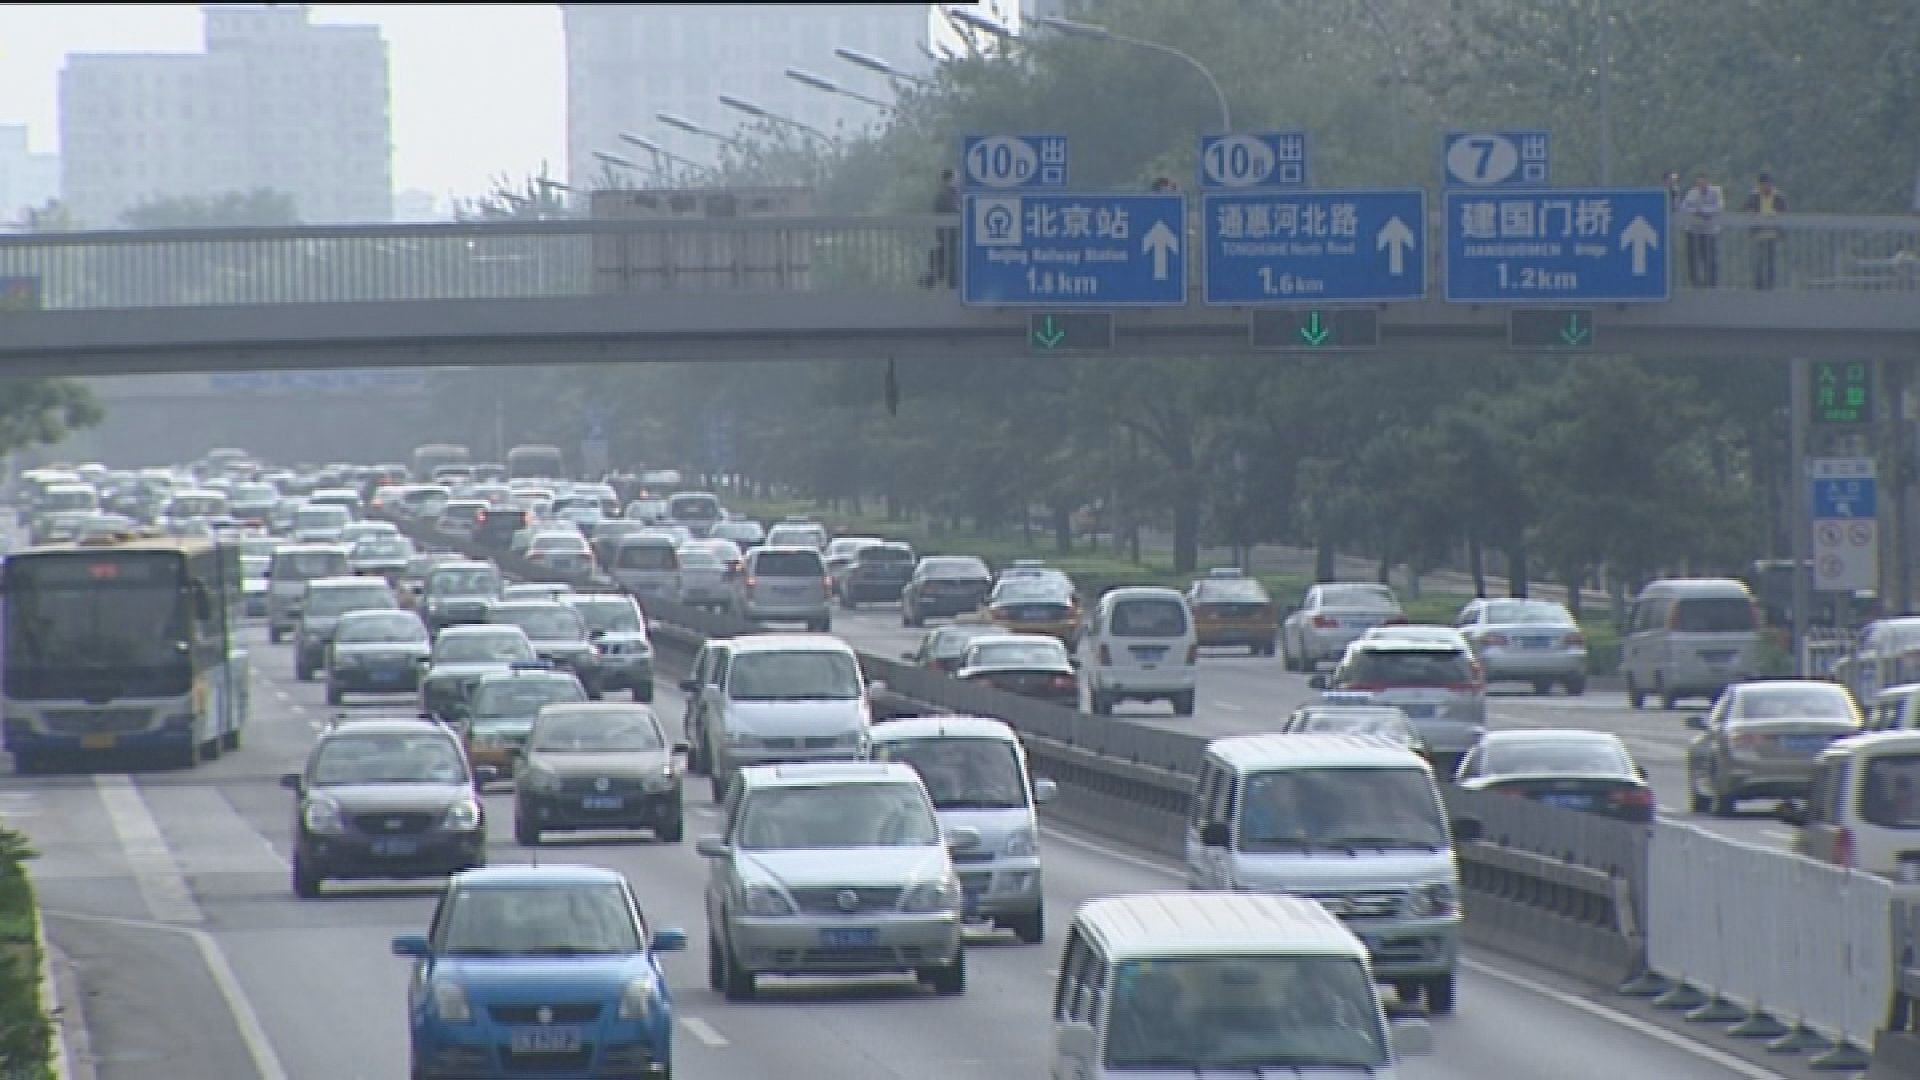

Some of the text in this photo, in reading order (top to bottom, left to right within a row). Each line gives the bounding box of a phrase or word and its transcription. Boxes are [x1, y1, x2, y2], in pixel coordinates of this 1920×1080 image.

[1042, 136, 1066, 185] 出口
[1279, 133, 1303, 183] 出口
[1470, 139, 1495, 179] 7
[1521, 133, 1547, 183] 出口
[1024, 202, 1129, 239] 北京站
[1216, 203, 1359, 239] 通惠河北路
[1460, 199, 1615, 239] 建国门桥
[1496, 262, 1578, 291] 1.2km
